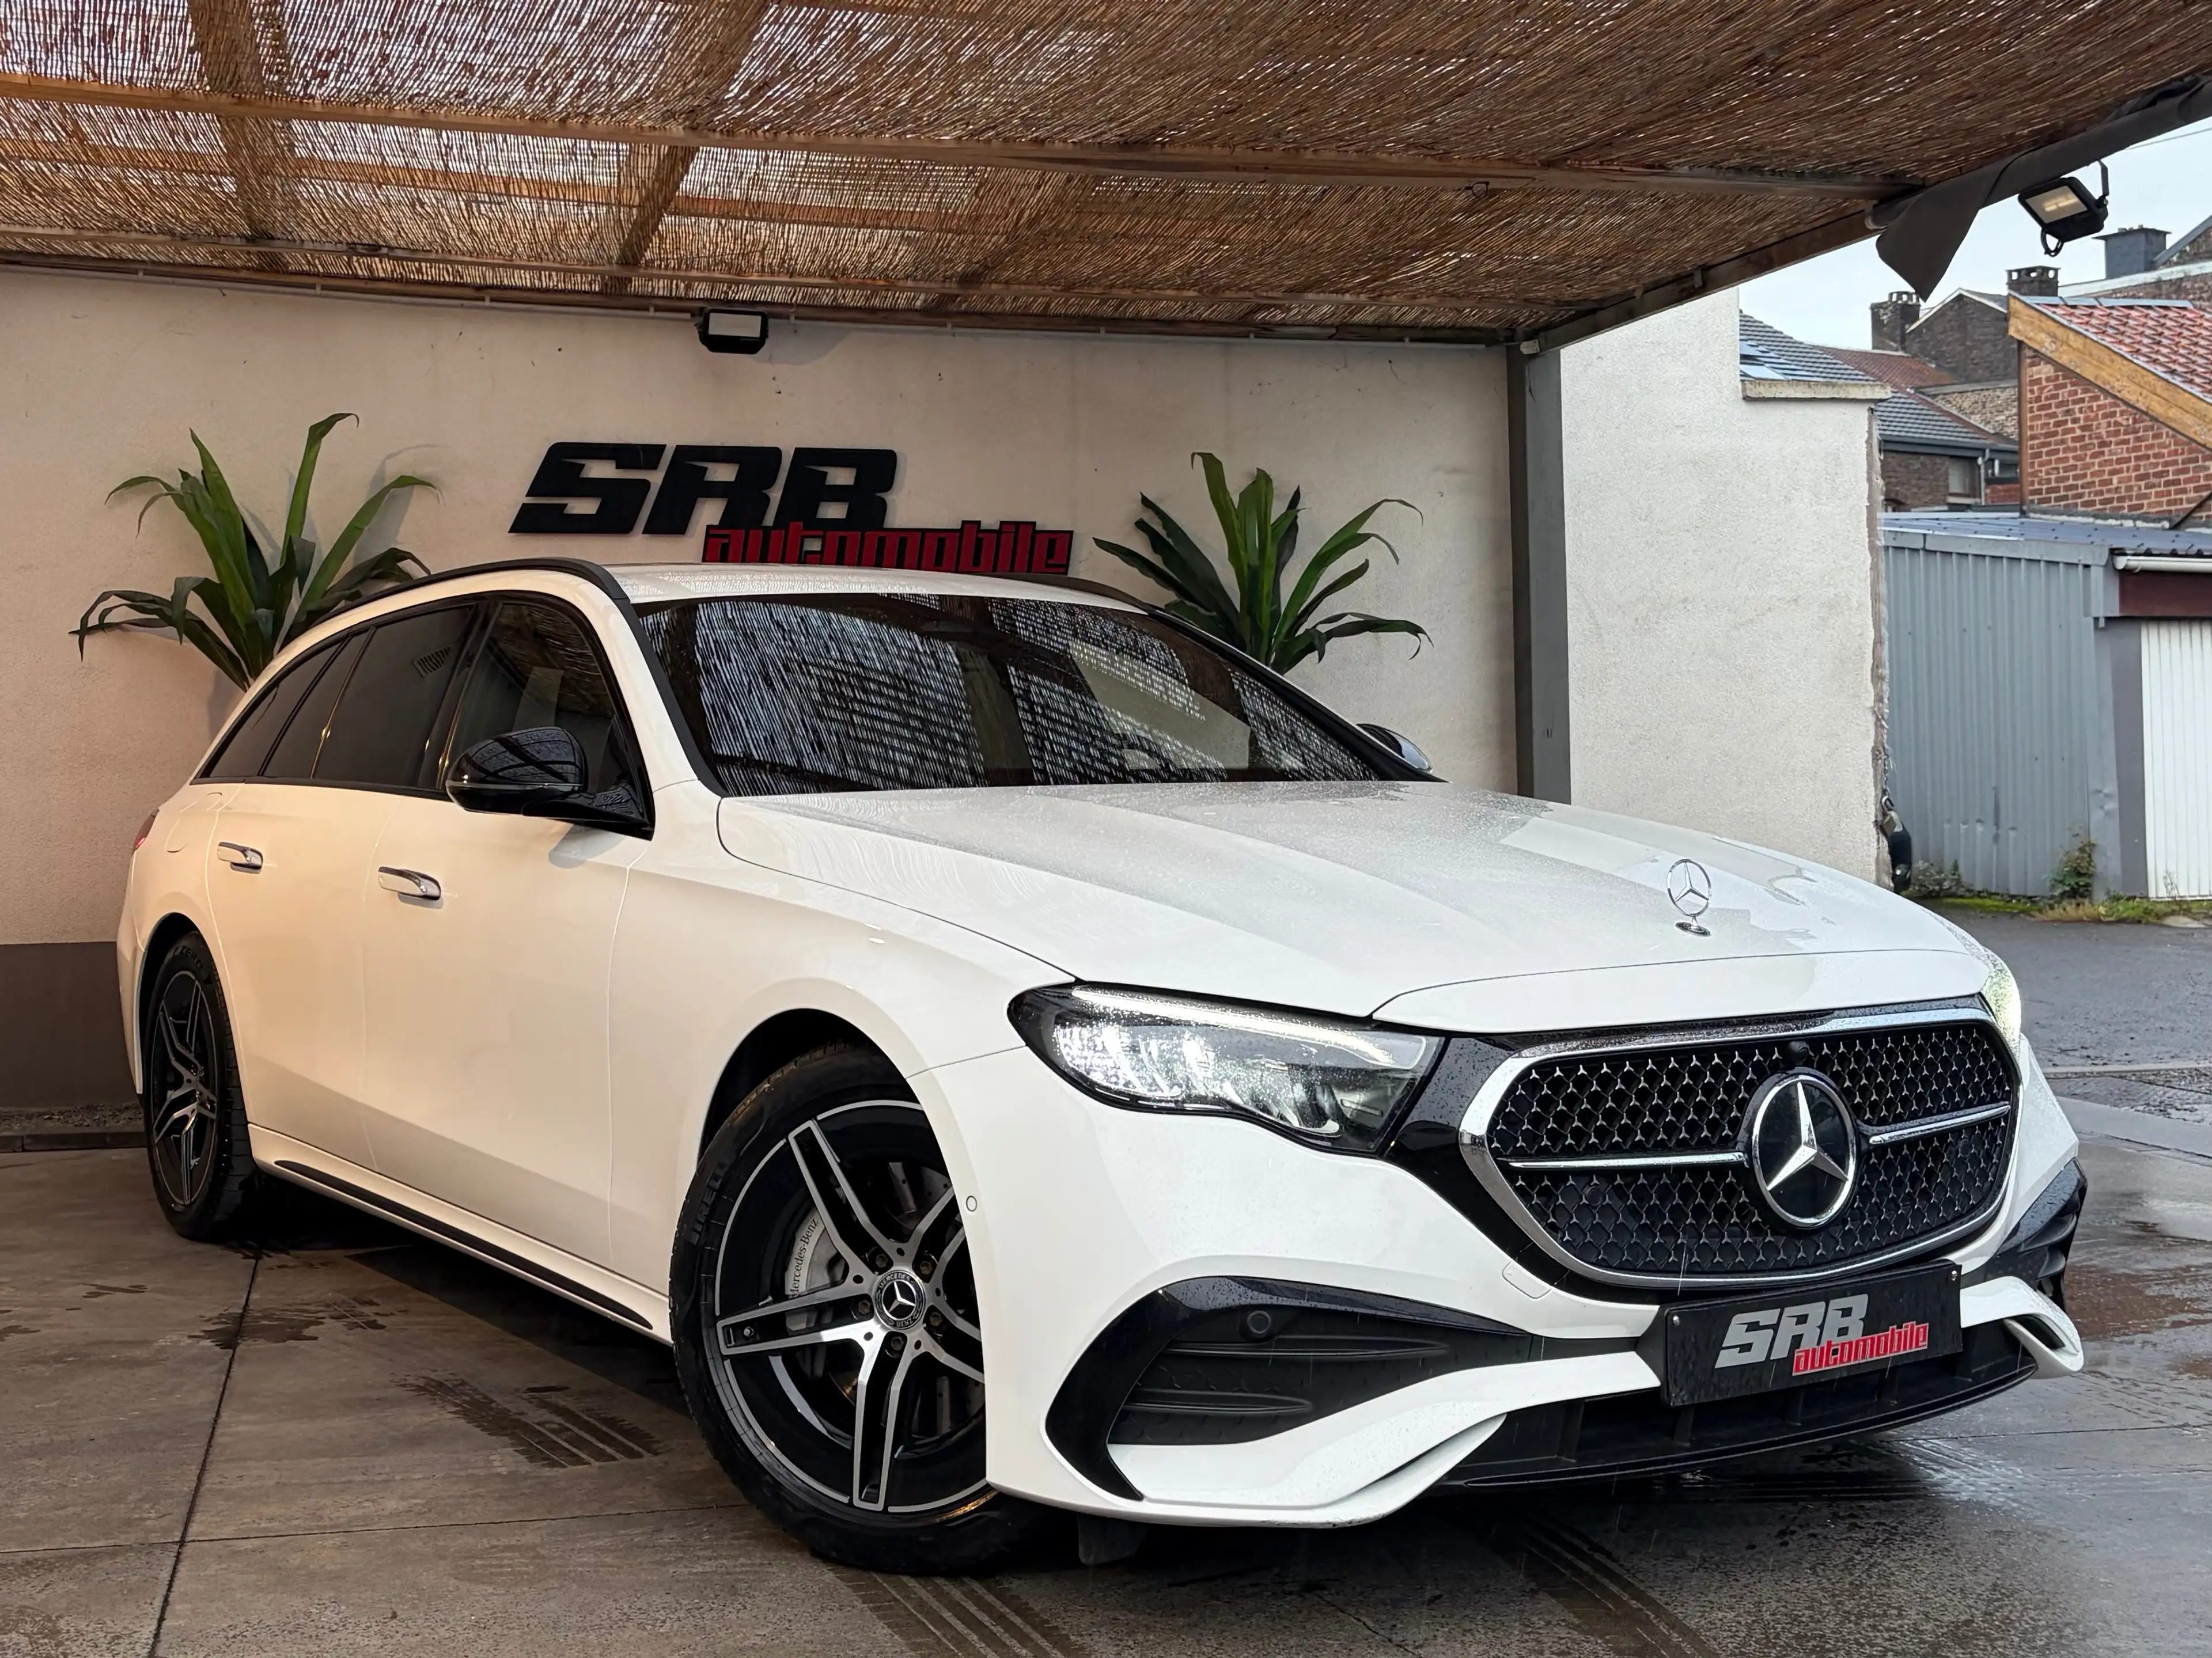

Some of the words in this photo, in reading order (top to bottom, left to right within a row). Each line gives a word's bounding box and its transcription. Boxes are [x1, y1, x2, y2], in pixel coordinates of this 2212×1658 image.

[508, 442, 898, 534] SRB
[702, 520, 1073, 575] automobile
[1714, 1293, 1869, 1369] SRB
[1792, 1321, 1929, 1376] automobile
